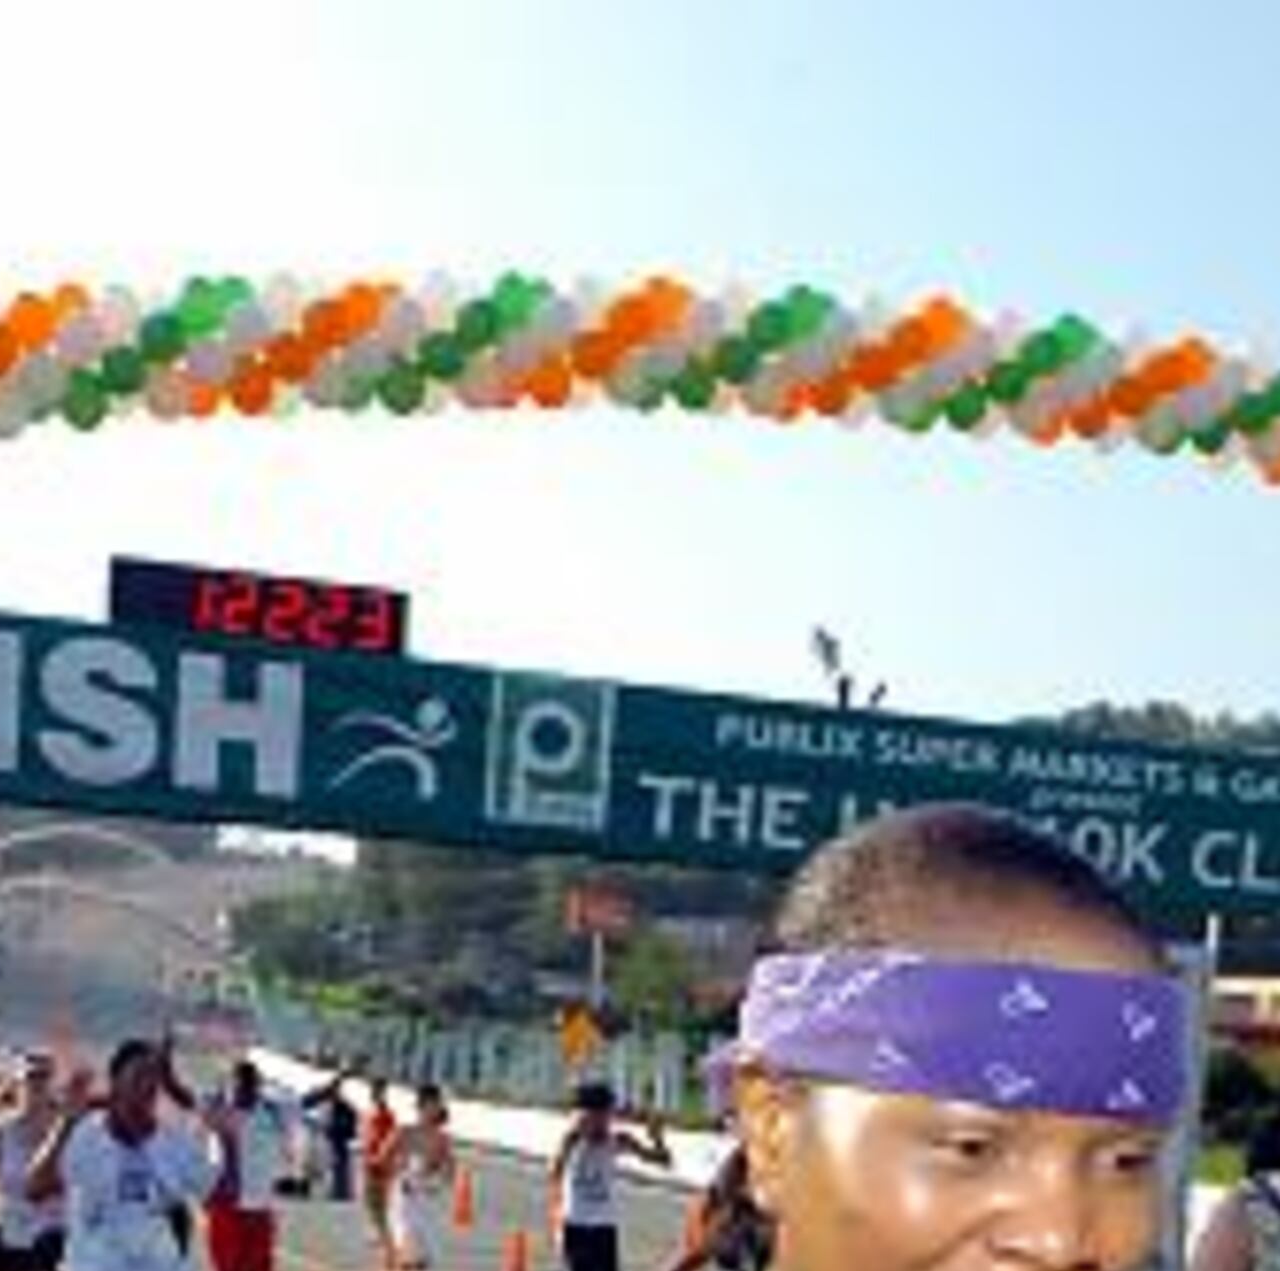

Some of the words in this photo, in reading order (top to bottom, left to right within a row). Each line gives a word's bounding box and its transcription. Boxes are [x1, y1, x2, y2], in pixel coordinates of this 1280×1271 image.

[715, 713, 863, 758] PUBLIX
[874, 729, 998, 772] SUPER
[1008, 747, 1185, 796] MARKETS
[637, 773, 811, 850] THE
